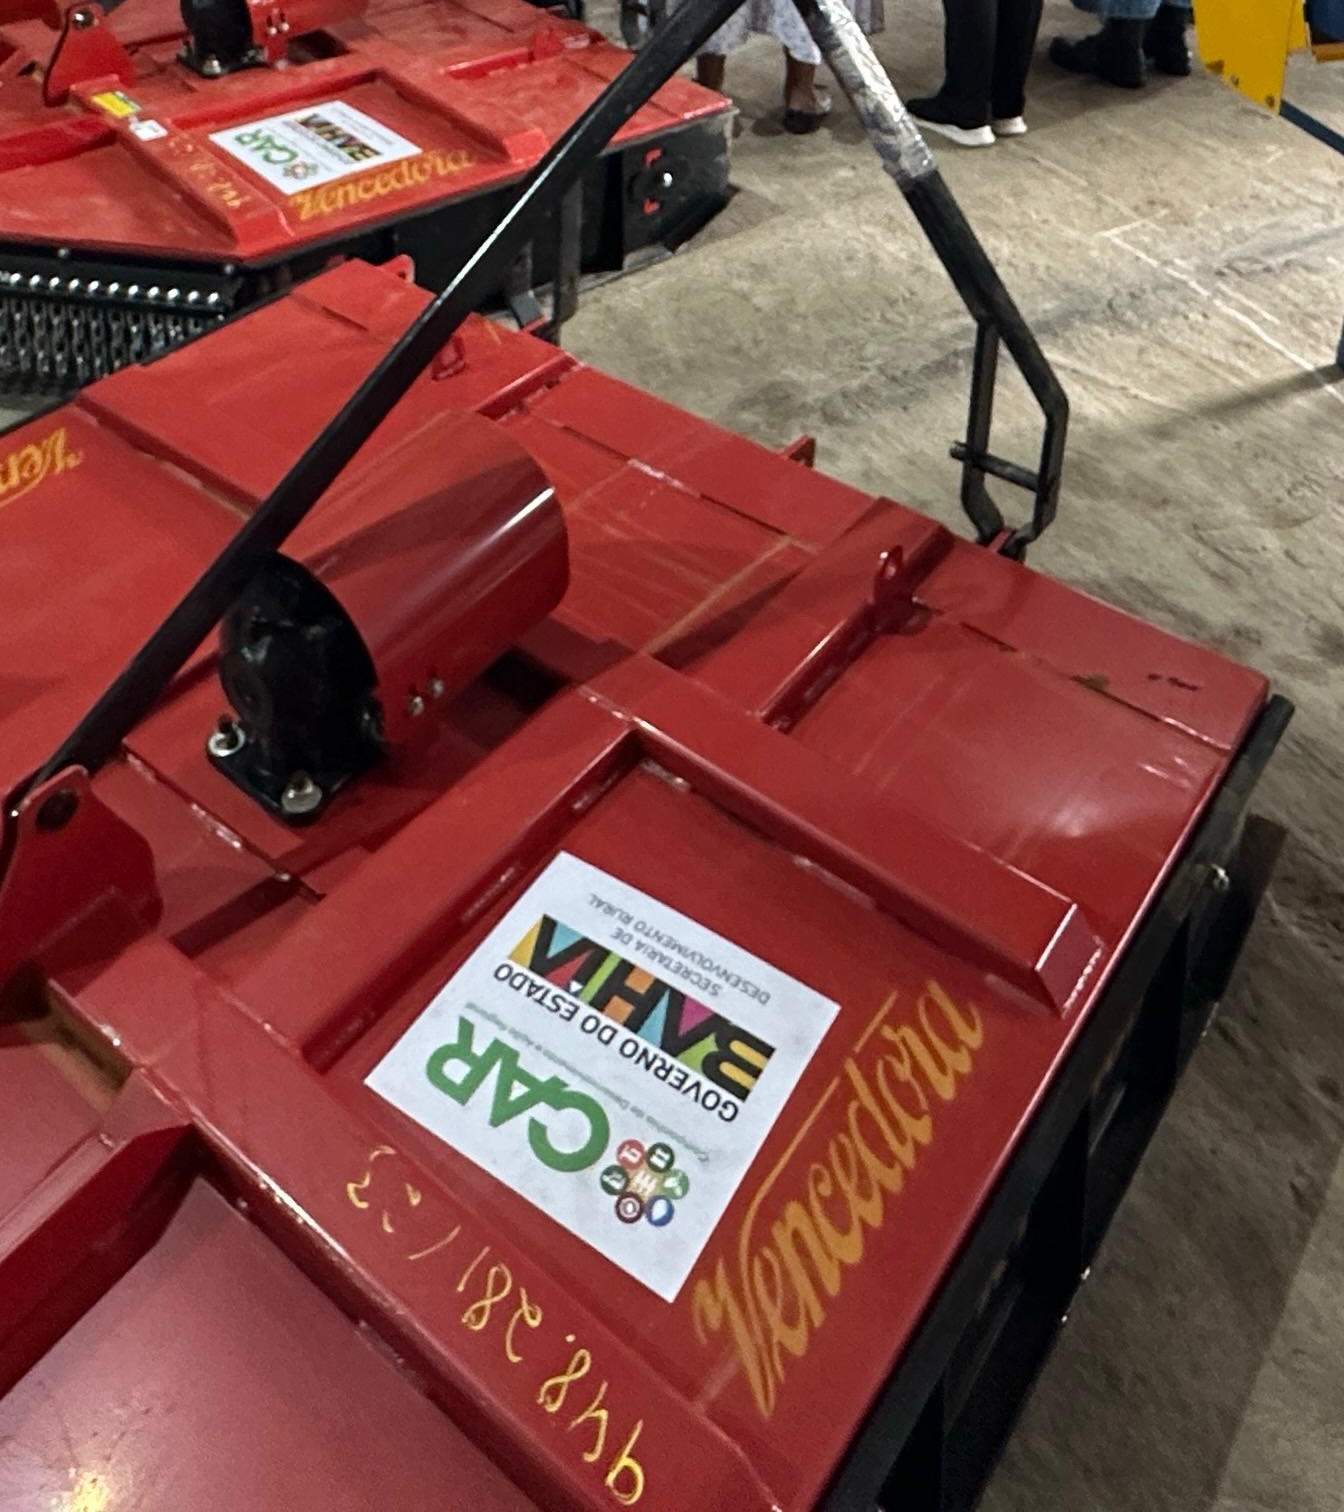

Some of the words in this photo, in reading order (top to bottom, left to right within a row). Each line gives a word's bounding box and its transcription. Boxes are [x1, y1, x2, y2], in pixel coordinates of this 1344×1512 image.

[234, 130, 298, 164] CAR
[292, 148, 474, 219] Vencedora
[587, 893, 635, 926] RURAL
[610, 927, 634, 945] DE
[492, 963, 580, 1023] ESTADO
[633, 919, 771, 1004] DESENVOLVIMENTO
[633, 940, 722, 996] SECRETARIA
[508, 914, 776, 1100] BAHIA
[581, 1014, 617, 1046] DO
[425, 1015, 609, 1172] CAR
[618, 1037, 739, 1122] GOVERNO
[692, 980, 984, 1418] Vencedora
